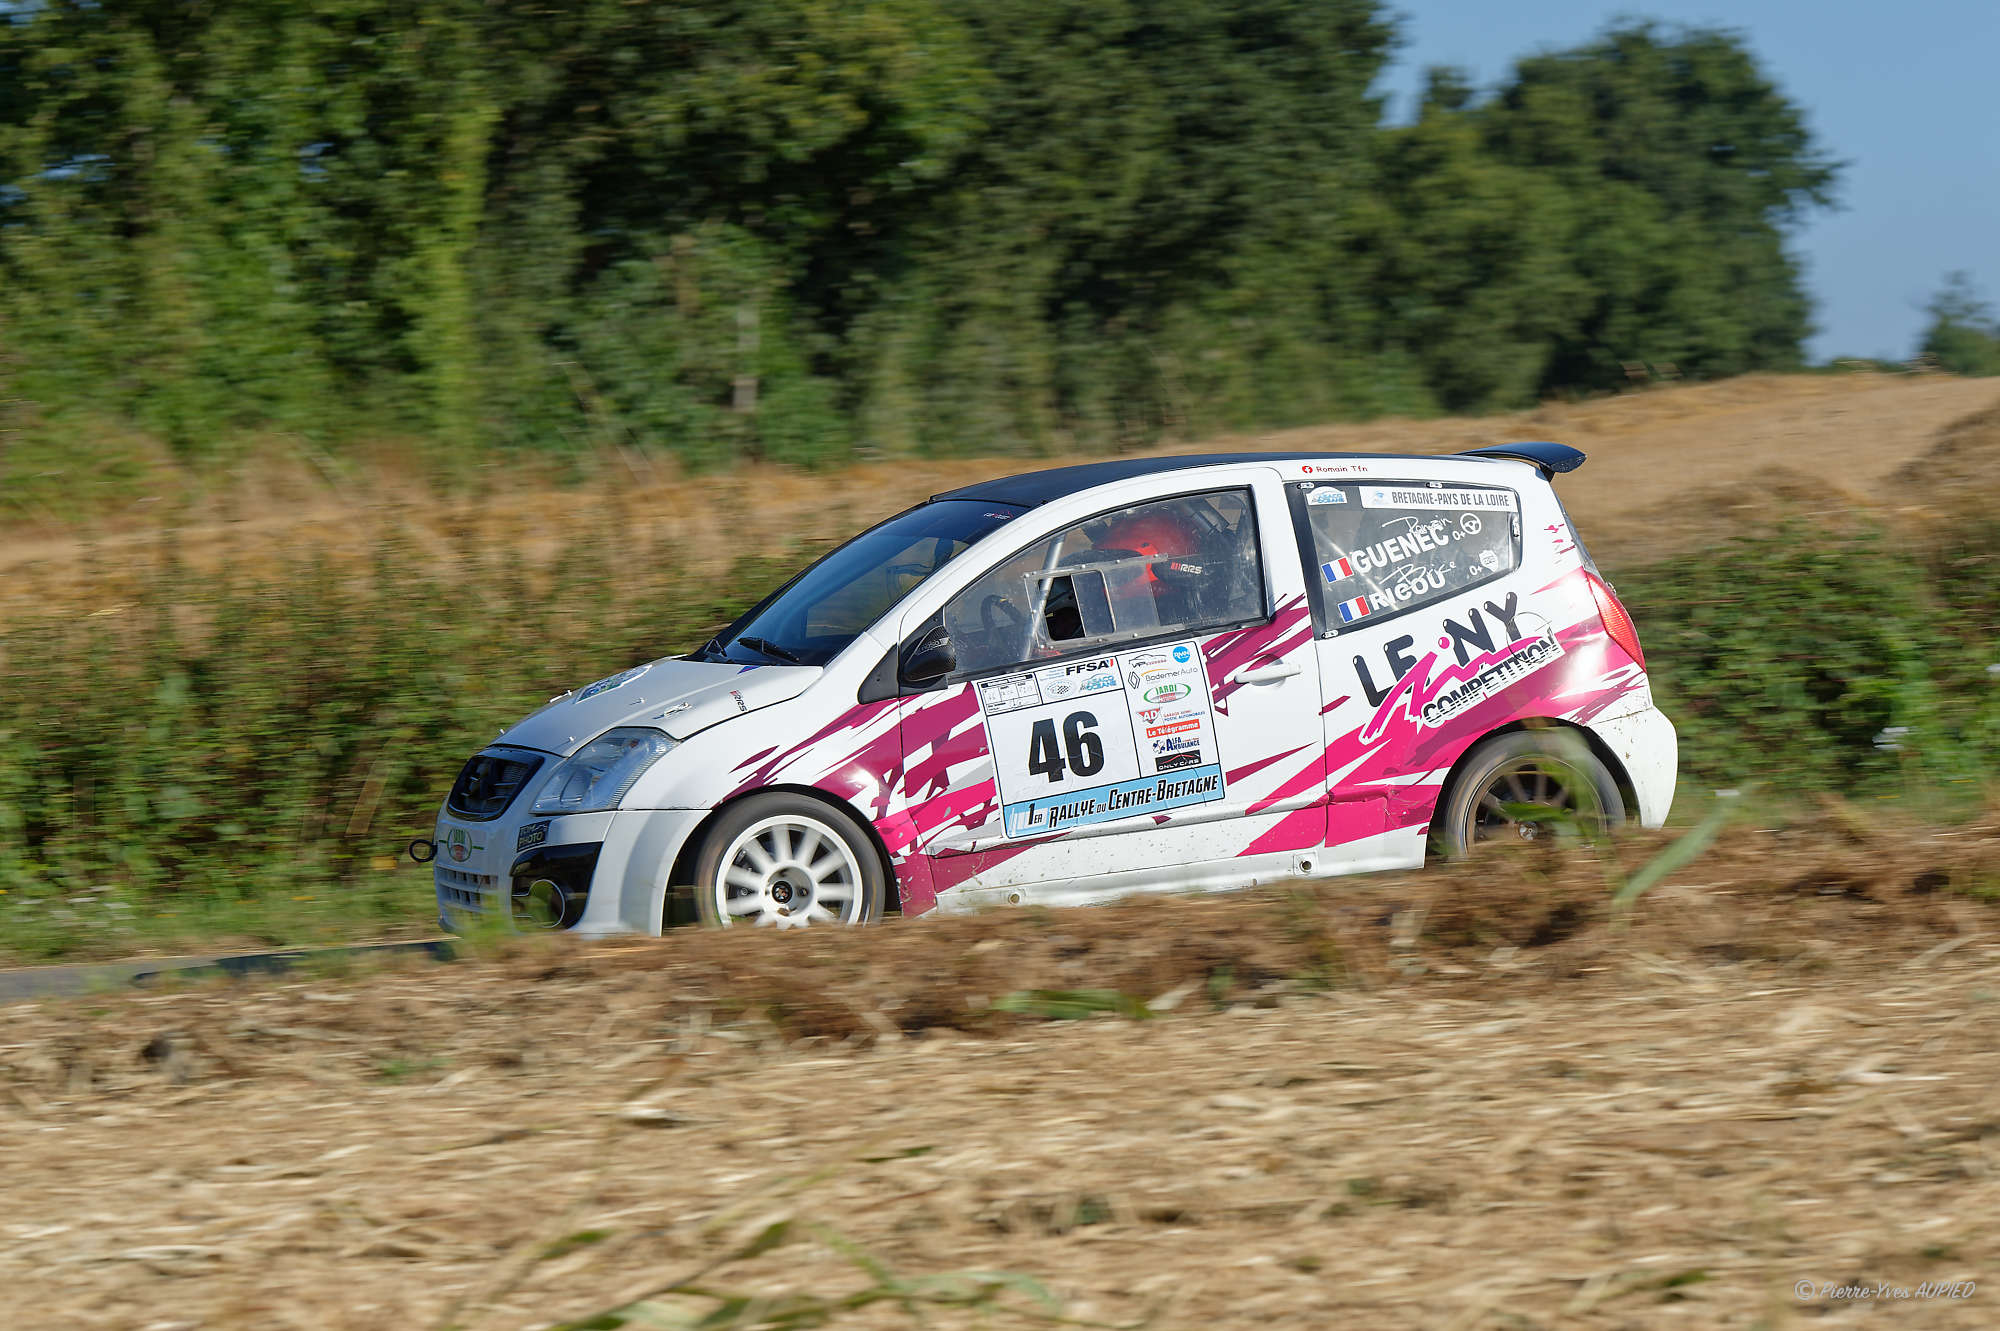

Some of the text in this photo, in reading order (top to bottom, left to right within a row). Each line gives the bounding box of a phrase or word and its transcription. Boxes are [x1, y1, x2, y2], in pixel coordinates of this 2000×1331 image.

[1316, 465, 1348, 473] Romain
[1392, 491, 1510, 506] BRETAGNE-PAYS DE LA LOIRE
[1351, 525, 1449, 574] GUENEC
[1368, 572, 1447, 611] RICOU
[1065, 659, 1110, 676] FFSA
[1143, 710, 1158, 721] AD
[1028, 710, 1105, 783] 46
[1048, 799, 1096, 829] RALLYE
[1108, 774, 1219, 811] CENTRE-BRETAGNE
